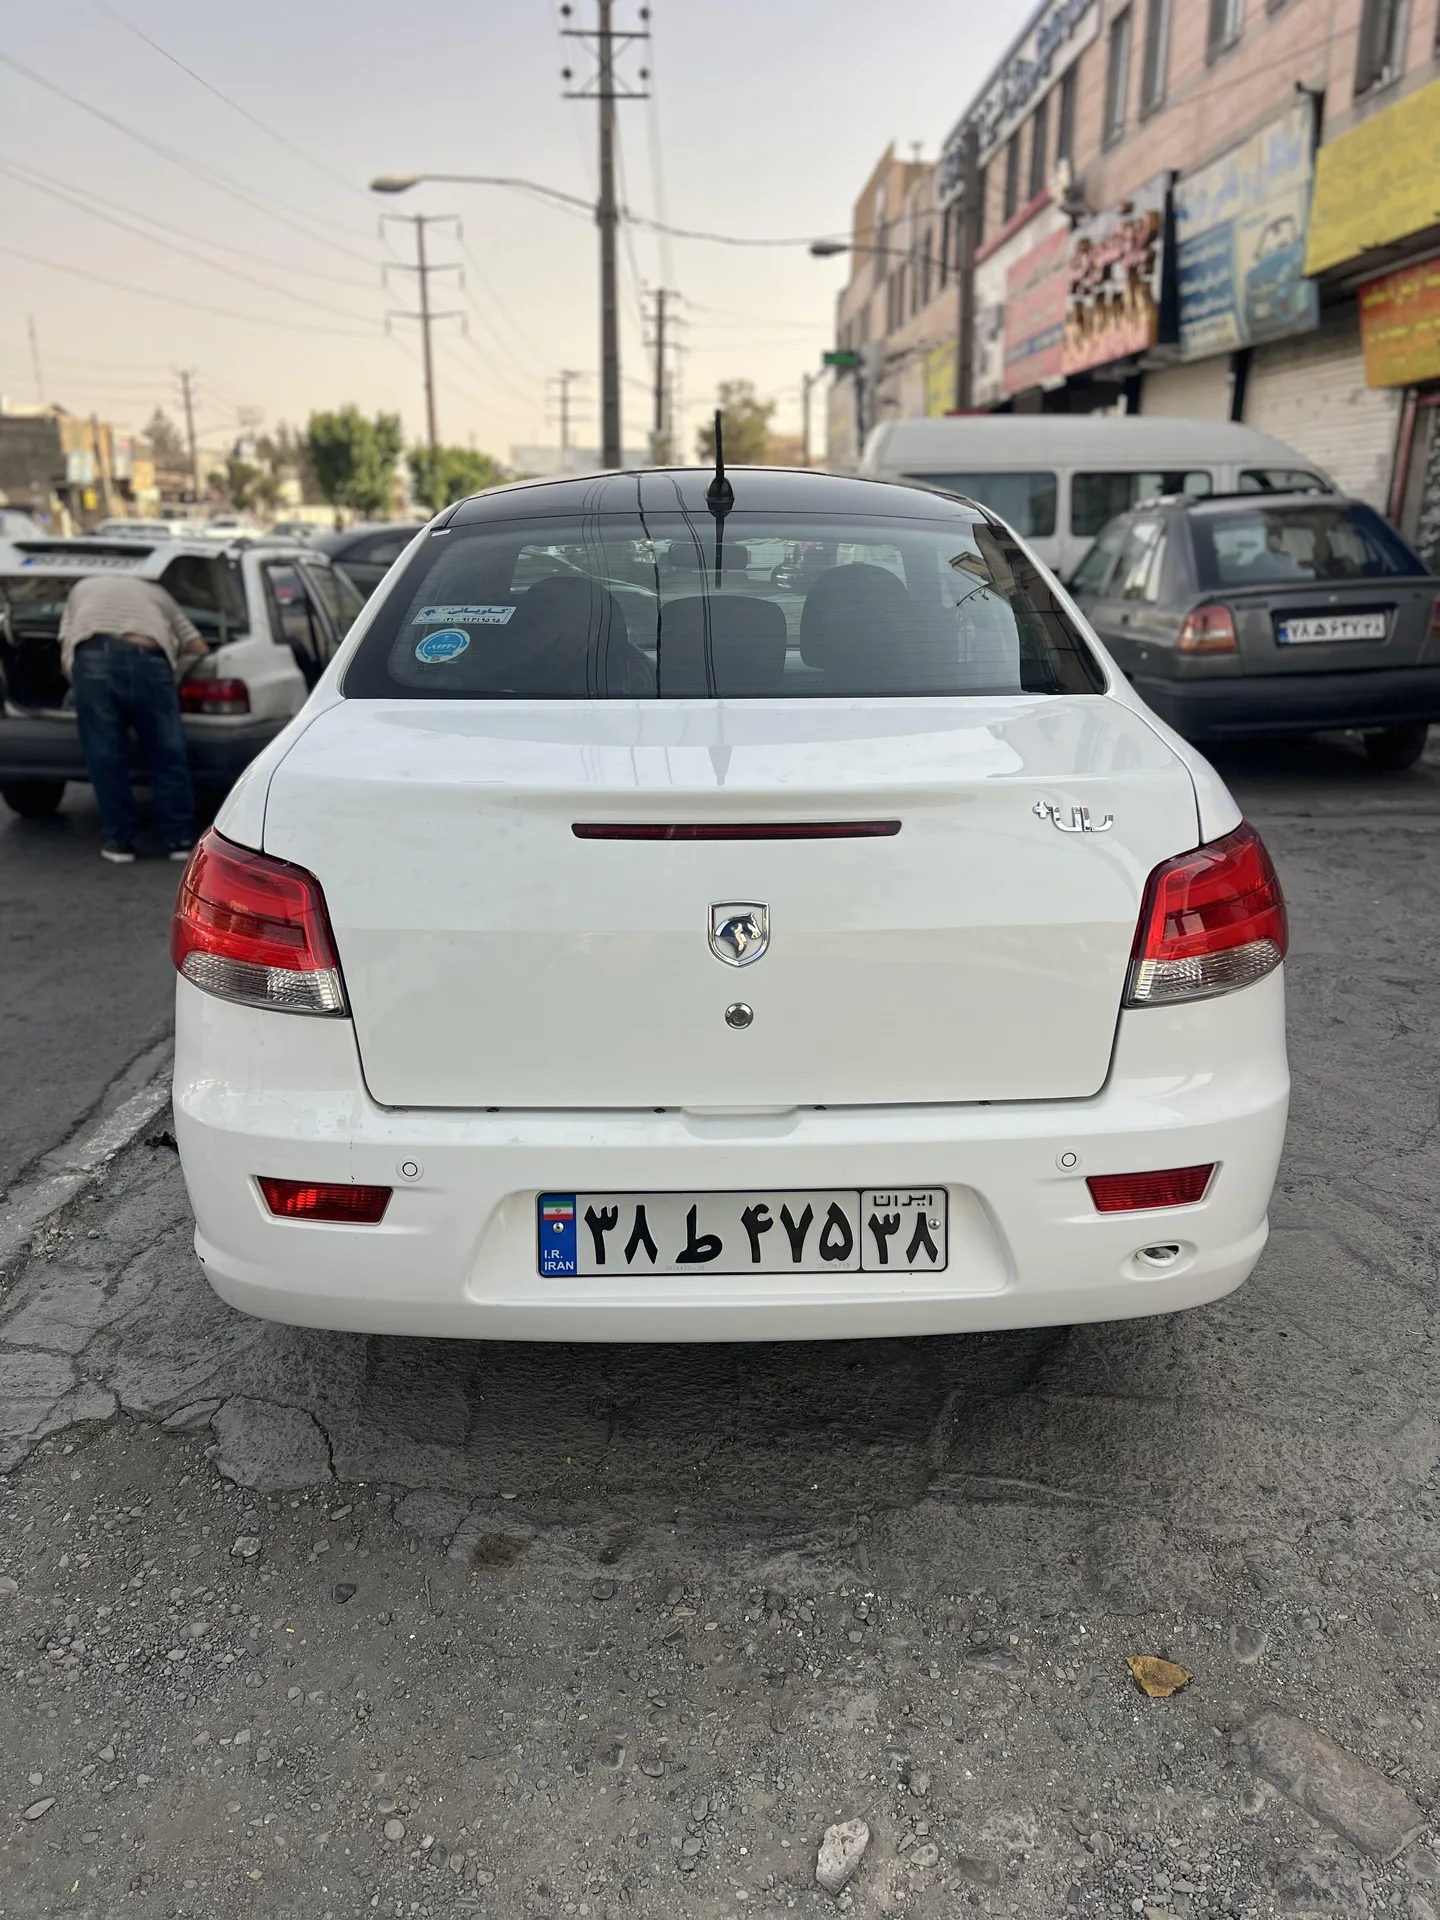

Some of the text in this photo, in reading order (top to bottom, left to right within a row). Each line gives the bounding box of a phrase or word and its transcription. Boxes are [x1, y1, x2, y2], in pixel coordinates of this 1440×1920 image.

[448, 607, 509, 616] کاویانی
[873, 1194, 933, 1207] ایران
[584, 1201, 939, 1265] ۳۸ ط ۴۷۵ ۳۸
[544, 1249, 563, 1259] I.R.
[544, 1261, 574, 1271] IRAN
